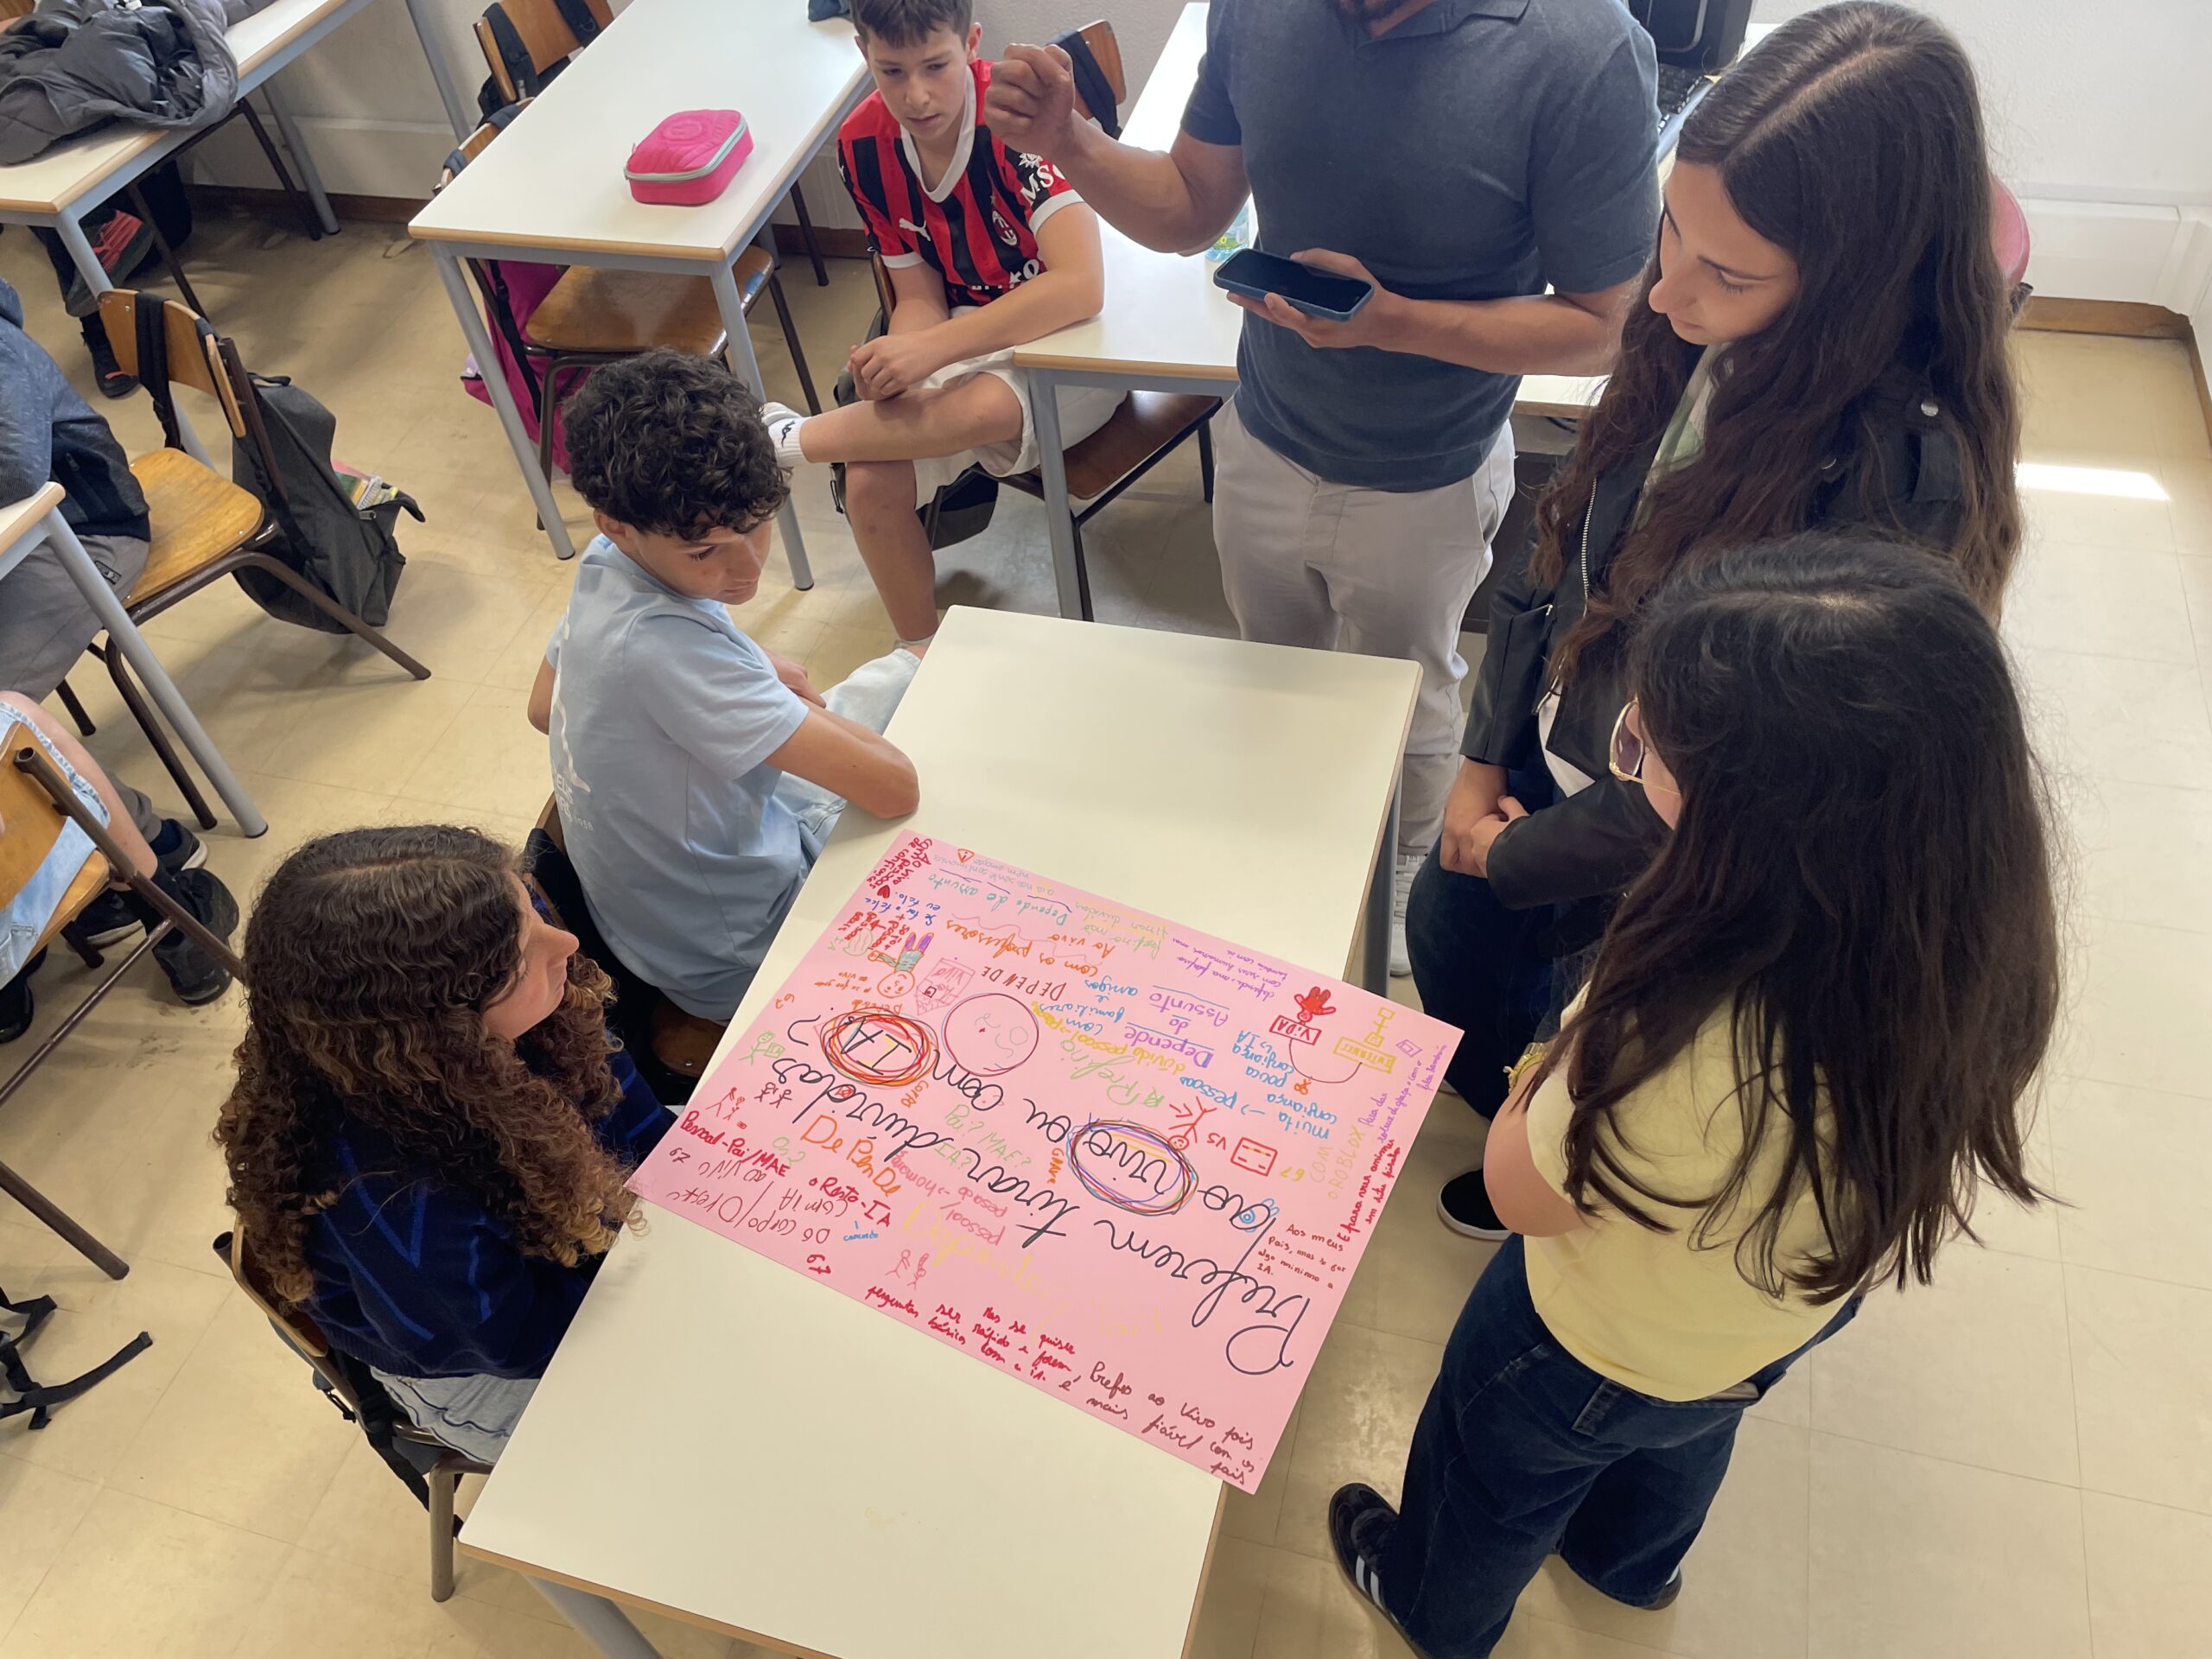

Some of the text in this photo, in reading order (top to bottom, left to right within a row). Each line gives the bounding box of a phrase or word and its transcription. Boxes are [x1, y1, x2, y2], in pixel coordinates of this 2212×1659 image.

[980, 965, 1068, 1002] DEPENDE
[1148, 992, 1230, 1027] Assunto
[1167, 1018, 1190, 1036] do
[1235, 1029, 1262, 1048] IA
[1123, 1025, 1215, 1070] Depende
[1231, 1042, 1297, 1075] confiança
[931, 1049, 1004, 1112] com
[1179, 1077, 1238, 1110] pessoas
[1244, 1065, 1289, 1089] pouca
[1023, 1098, 1071, 1144] ou
[1266, 1092, 1338, 1126] confiança
[1277, 1110, 1331, 1141] muita
[1082, 1128, 1167, 1195] vivo
[963, 1147, 1081, 1249] tirar
[1197, 1185, 1270, 1230] ao
[1286, 1224, 1306, 1237] Aos
[1093, 1217, 1311, 1376] Preferem
[1085, 1395, 1128, 1421] mais
[1147, 1392, 1166, 1408] ao
[1209, 1460, 1245, 1485] pais
